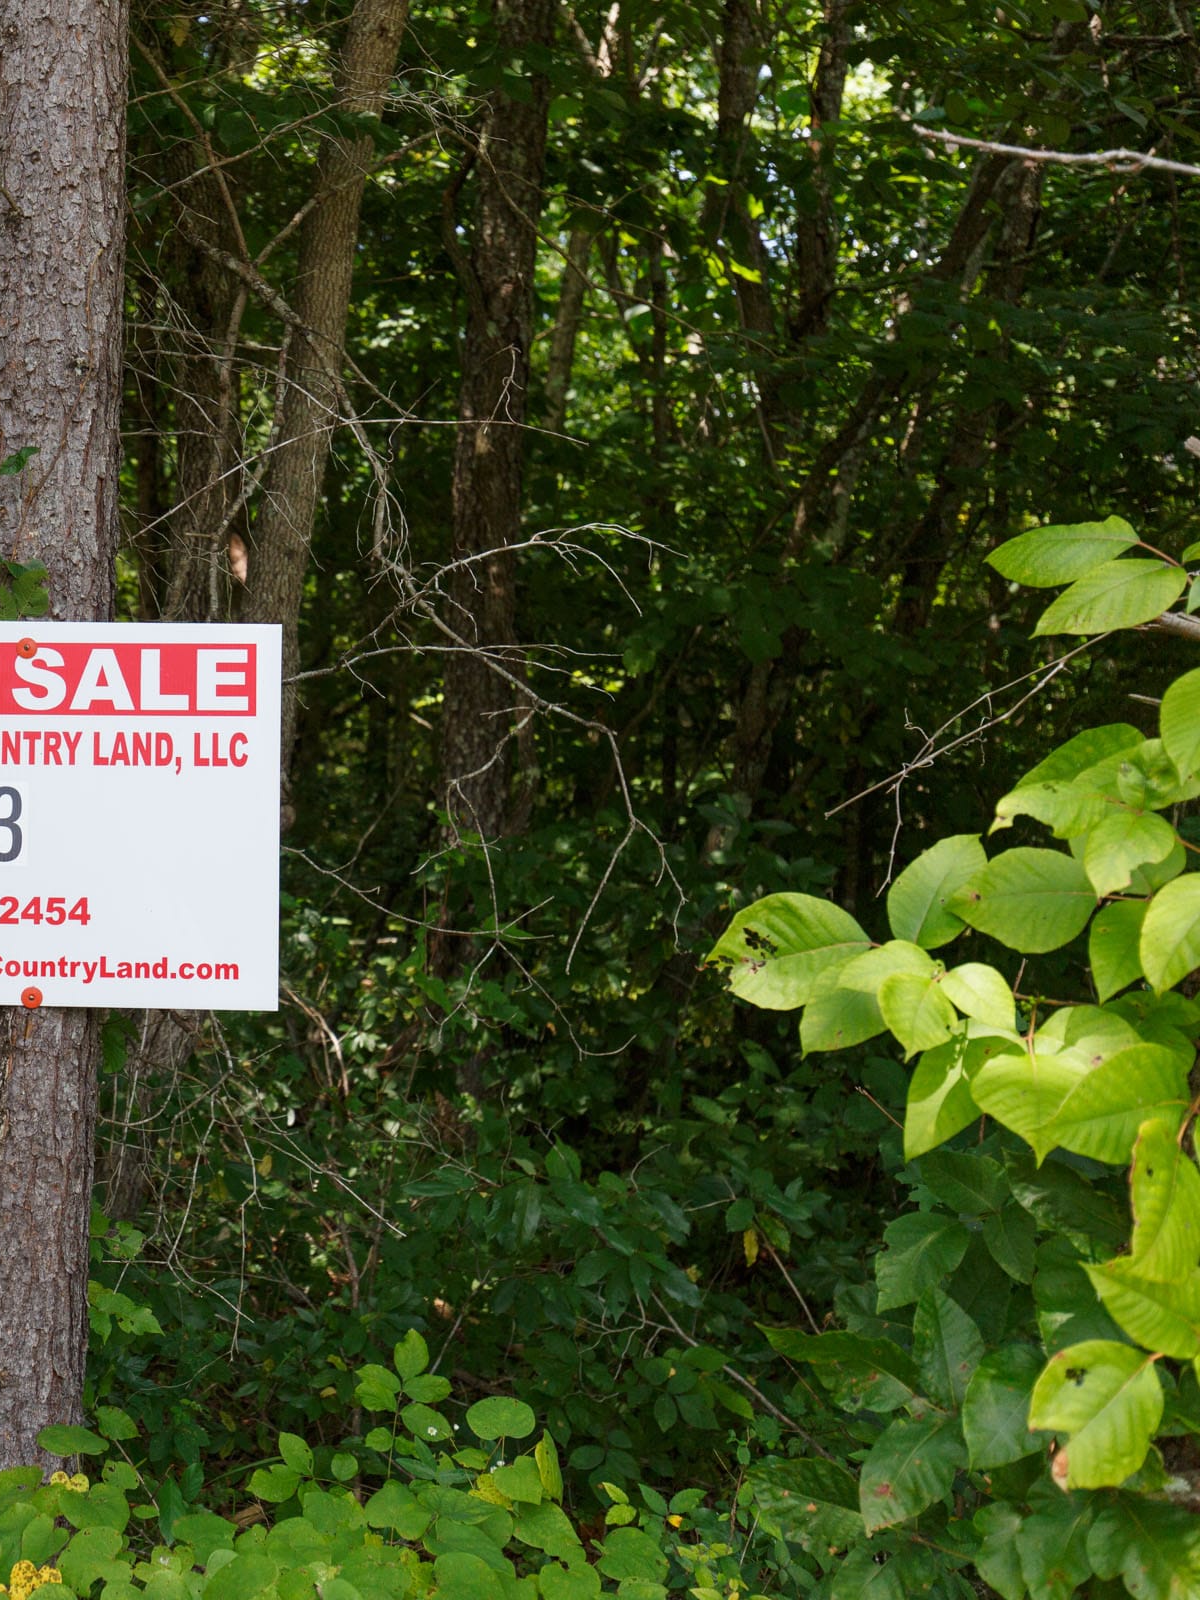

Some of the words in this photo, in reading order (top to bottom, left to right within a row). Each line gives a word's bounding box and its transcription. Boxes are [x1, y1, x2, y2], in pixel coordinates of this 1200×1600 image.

[11, 647, 249, 711] SALE
[92, 731, 182, 775] LAND,
[193, 732, 249, 768] LLC
